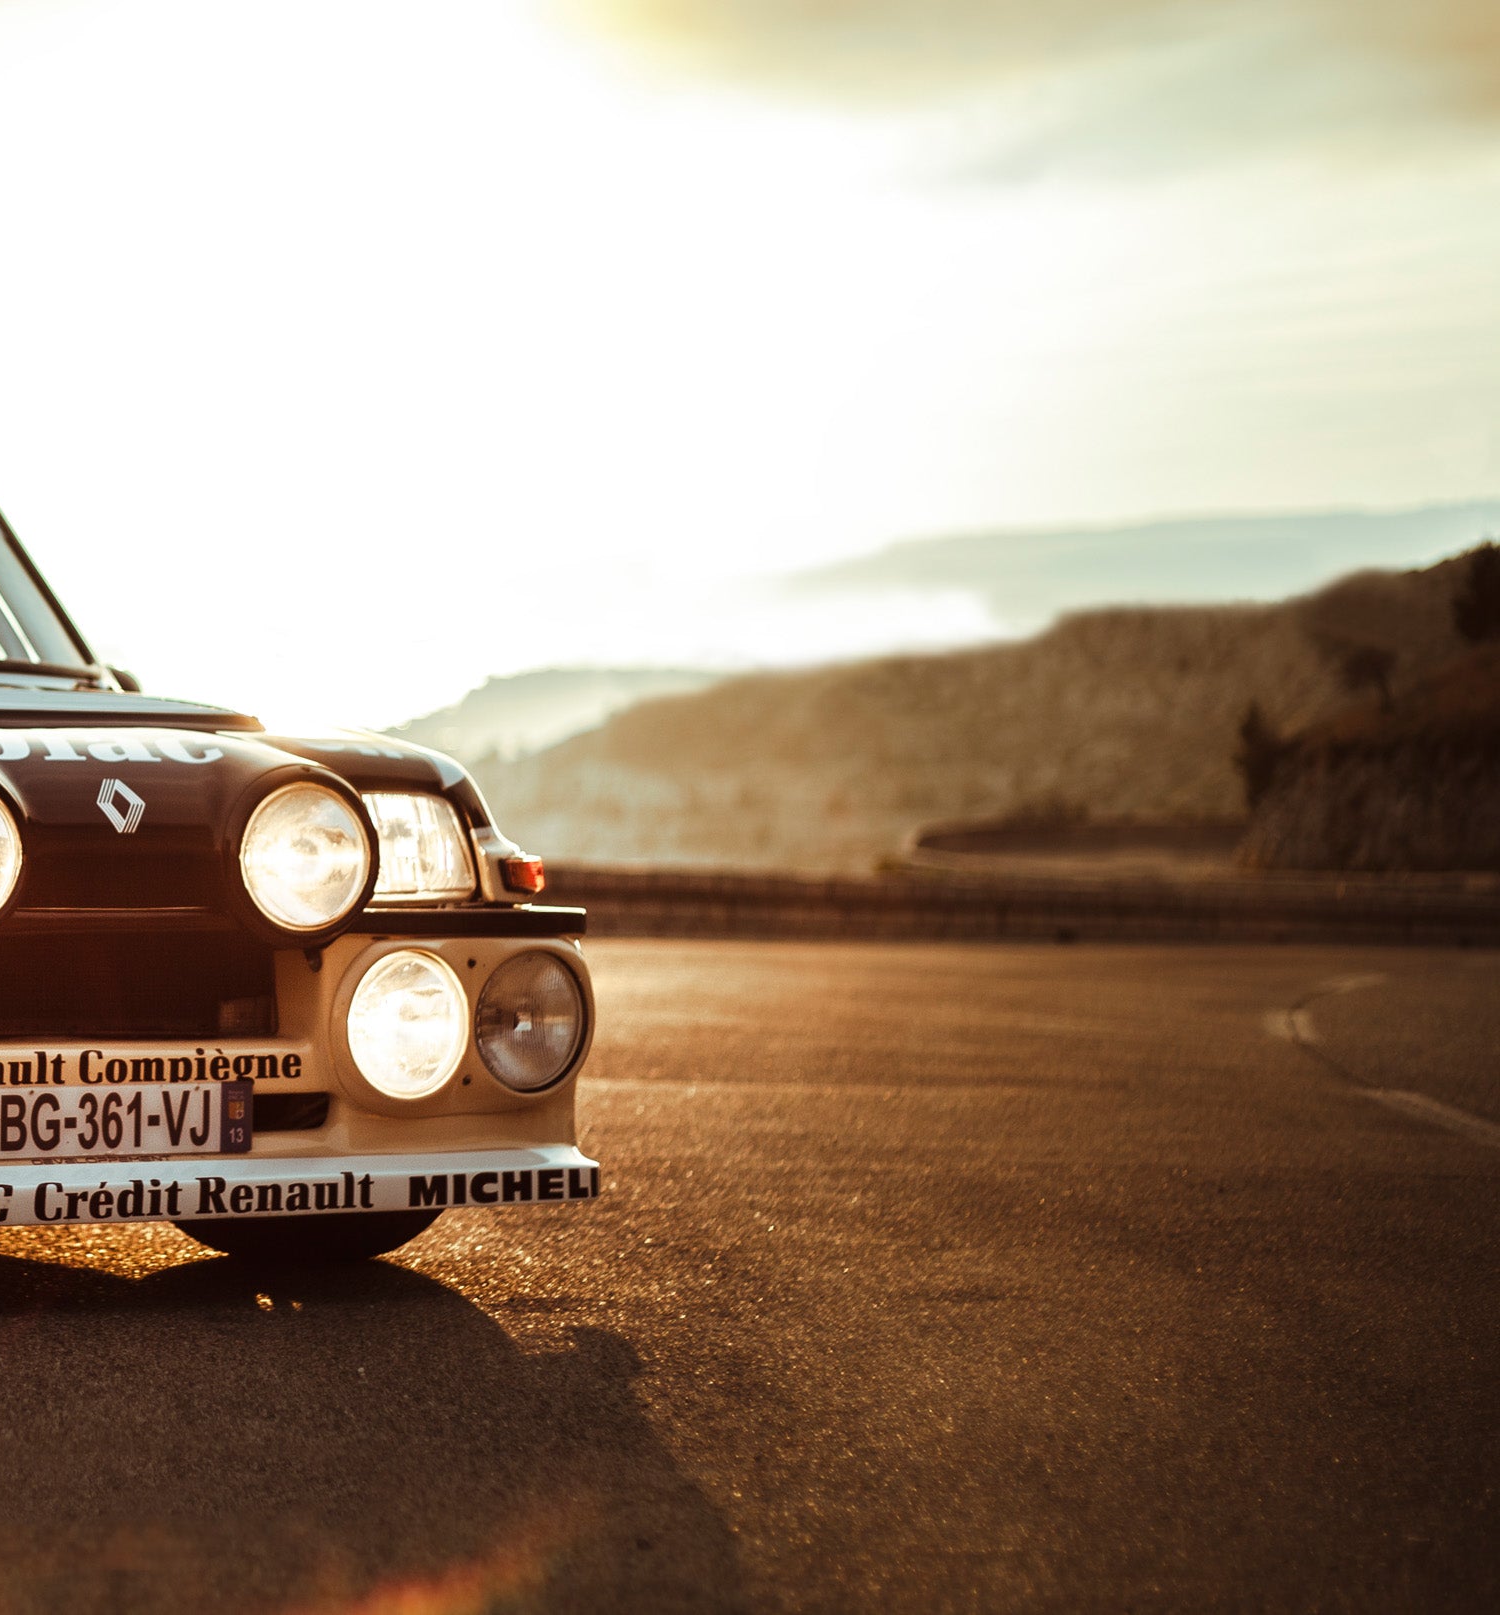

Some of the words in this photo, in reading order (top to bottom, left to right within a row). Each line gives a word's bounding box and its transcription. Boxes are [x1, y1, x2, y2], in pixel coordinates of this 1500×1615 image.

[79, 1048, 302, 1083] Compiègne
[0, 1090, 211, 1151] BG-361-VJ
[229, 1127, 244, 1144] 13
[34, 1182, 183, 1222] Crédit
[194, 1172, 374, 1216] Renault
